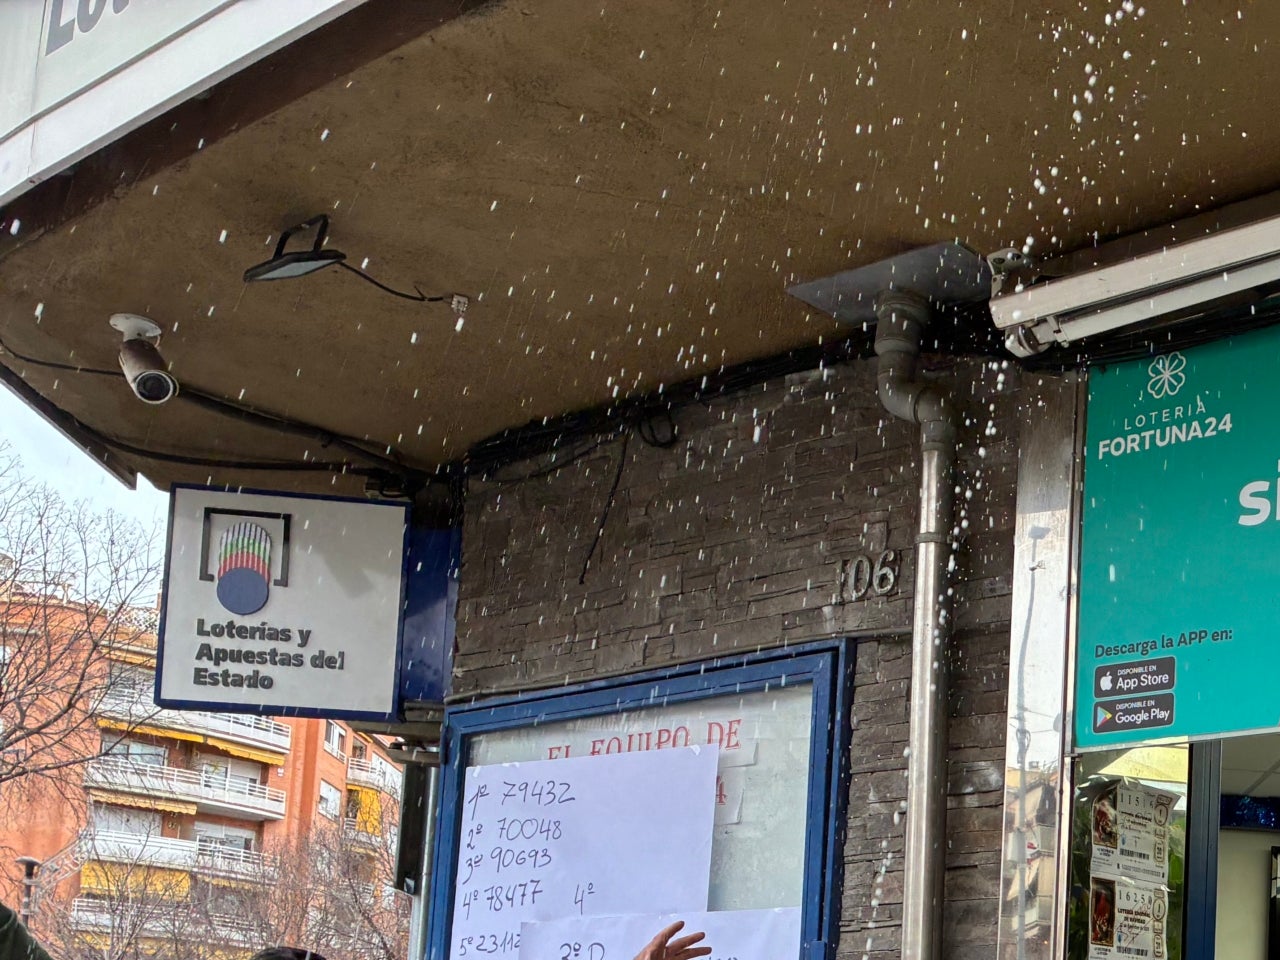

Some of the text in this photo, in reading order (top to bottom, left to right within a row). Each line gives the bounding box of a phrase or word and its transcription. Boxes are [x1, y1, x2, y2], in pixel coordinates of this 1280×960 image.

[1124, 402, 1206, 430] LOTERIA
[1098, 413, 1233, 460] FORTUNA24
[196, 618, 312, 648] Loterías y
[1095, 629, 1233, 658] Descarga la APP en:
[195, 643, 345, 670] Apuestas del
[1148, 664, 1157, 672] EN
[193, 667, 274, 690] Estado
[1116, 673, 1170, 691] App Store
[1115, 708, 1170, 725] Google Play
[706, 719, 742, 751] DE
[501, 780, 576, 806] 79432
[497, 817, 562, 841] 70048
[490, 846, 552, 873] 90693
[484, 879, 544, 912] 78477
